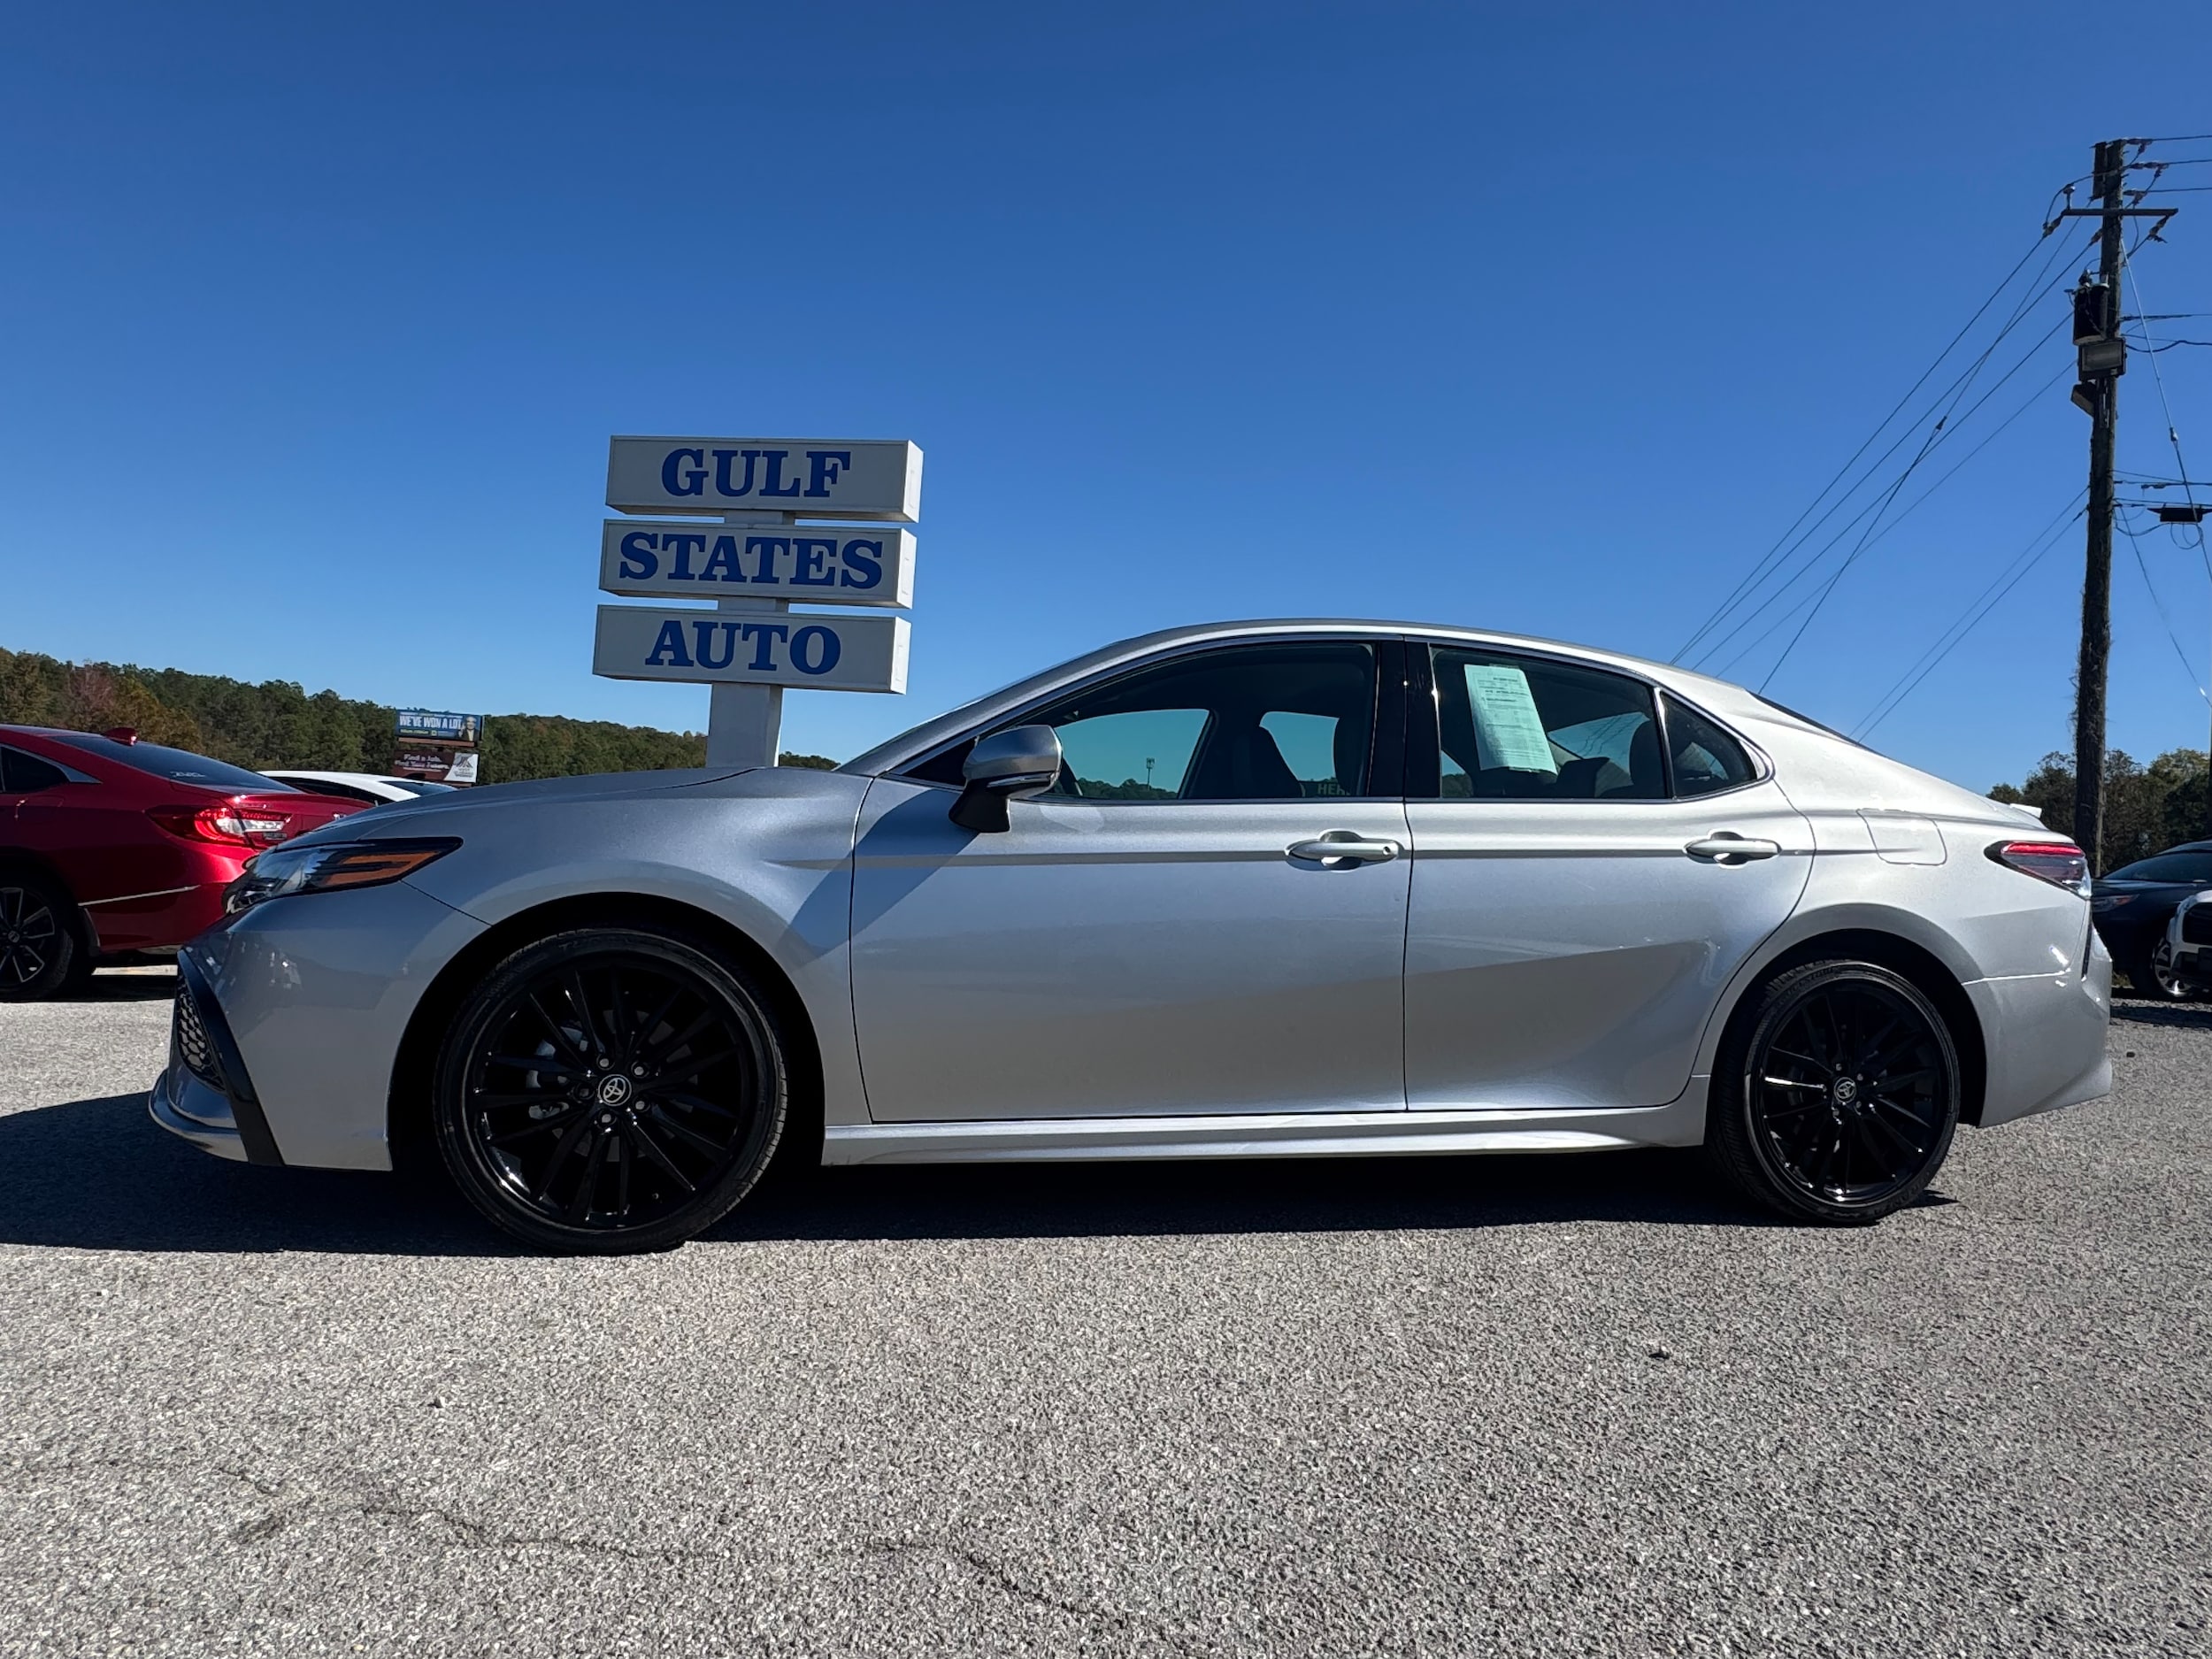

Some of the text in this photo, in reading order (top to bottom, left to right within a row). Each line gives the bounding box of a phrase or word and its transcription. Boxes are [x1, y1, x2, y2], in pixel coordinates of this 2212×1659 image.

[661, 448, 851, 498] GULF
[619, 531, 883, 589] STATES
[644, 619, 841, 675] AUTO
[399, 715, 422, 727] WE'VE
[423, 716, 442, 728] WON
[442, 718, 448, 729] A
